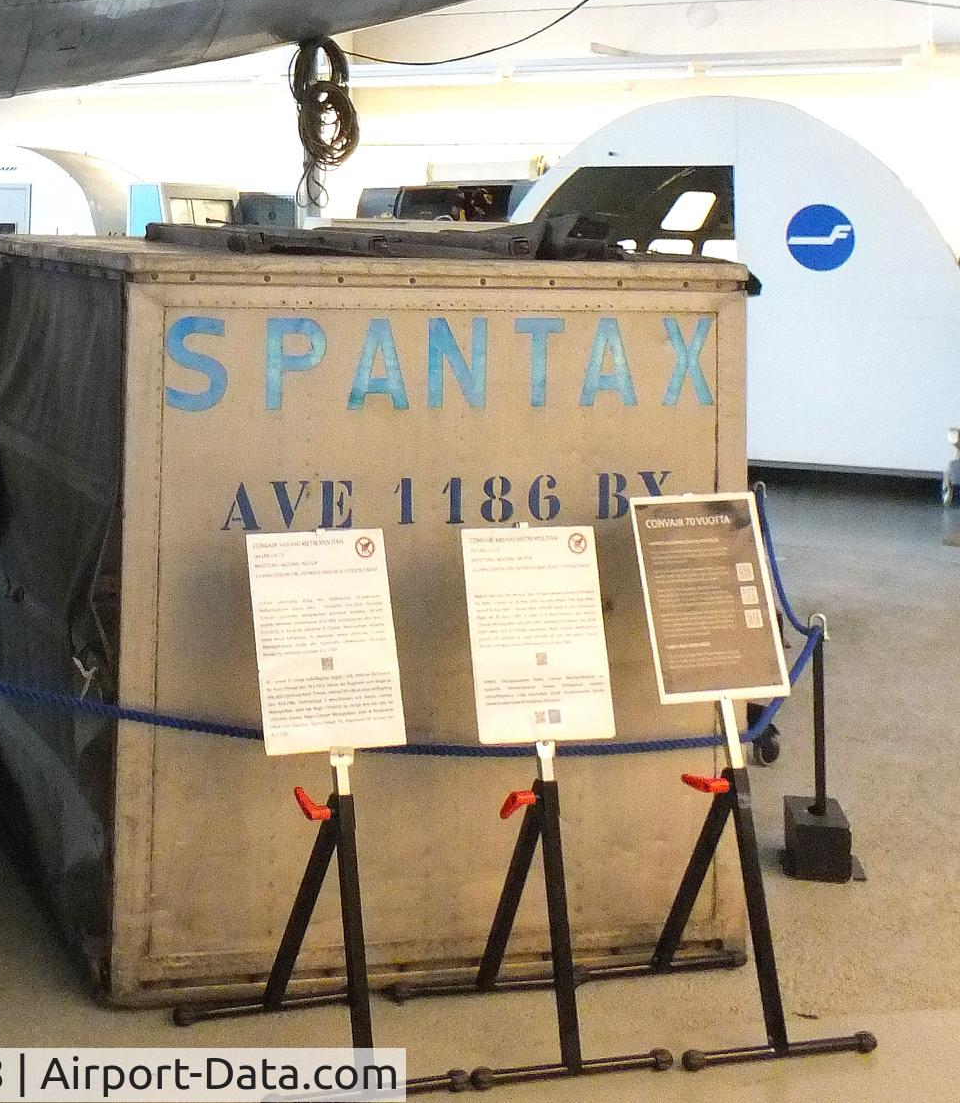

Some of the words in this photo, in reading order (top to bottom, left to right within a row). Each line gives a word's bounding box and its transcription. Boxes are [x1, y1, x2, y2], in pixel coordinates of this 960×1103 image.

[163, 315, 717, 413] SPANTAX
[220, 480, 354, 532] AVE
[394, 474, 562, 525] 1186
